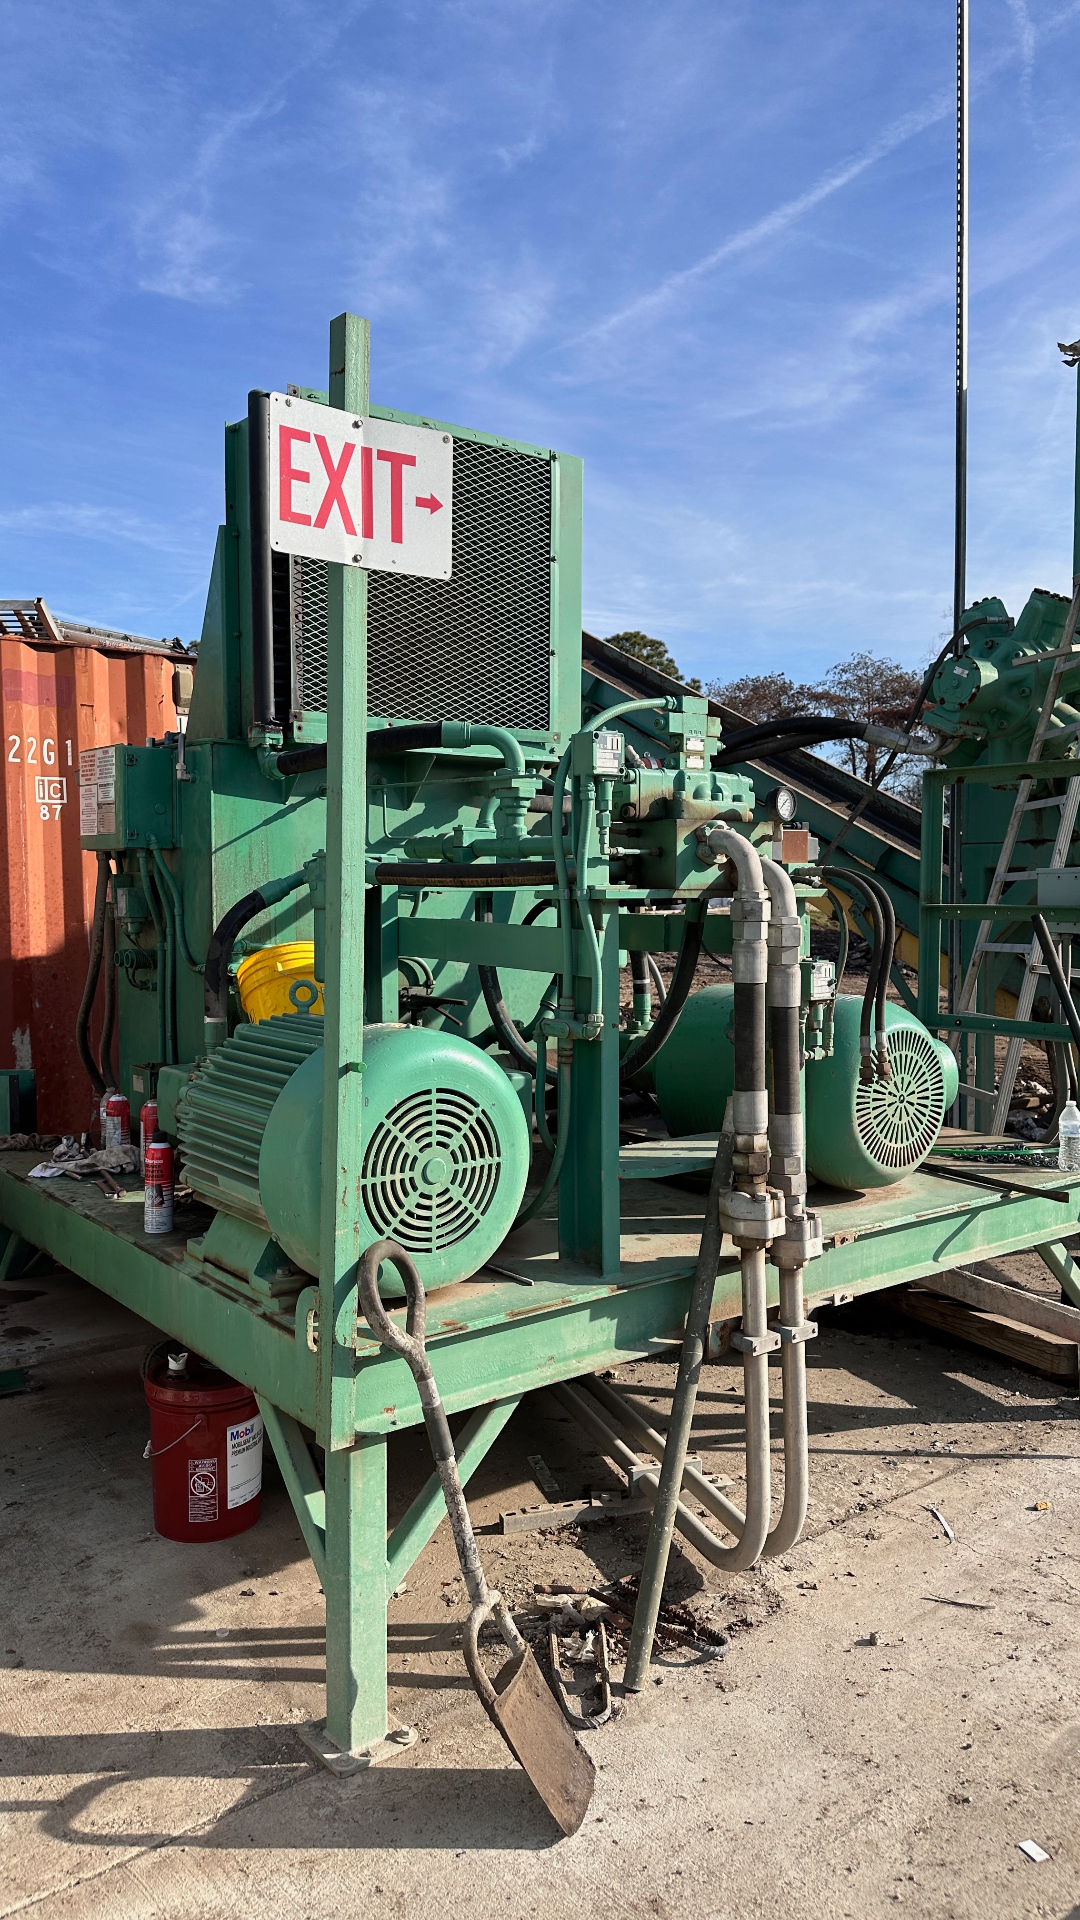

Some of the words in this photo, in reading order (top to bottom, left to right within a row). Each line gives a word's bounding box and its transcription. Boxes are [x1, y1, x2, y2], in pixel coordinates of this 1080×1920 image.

[279, 425, 417, 544] EXIT
[8, 734, 73, 766] 22G1
[39, 804, 62, 821] 87
[230, 1423, 255, 1441] Mobil
